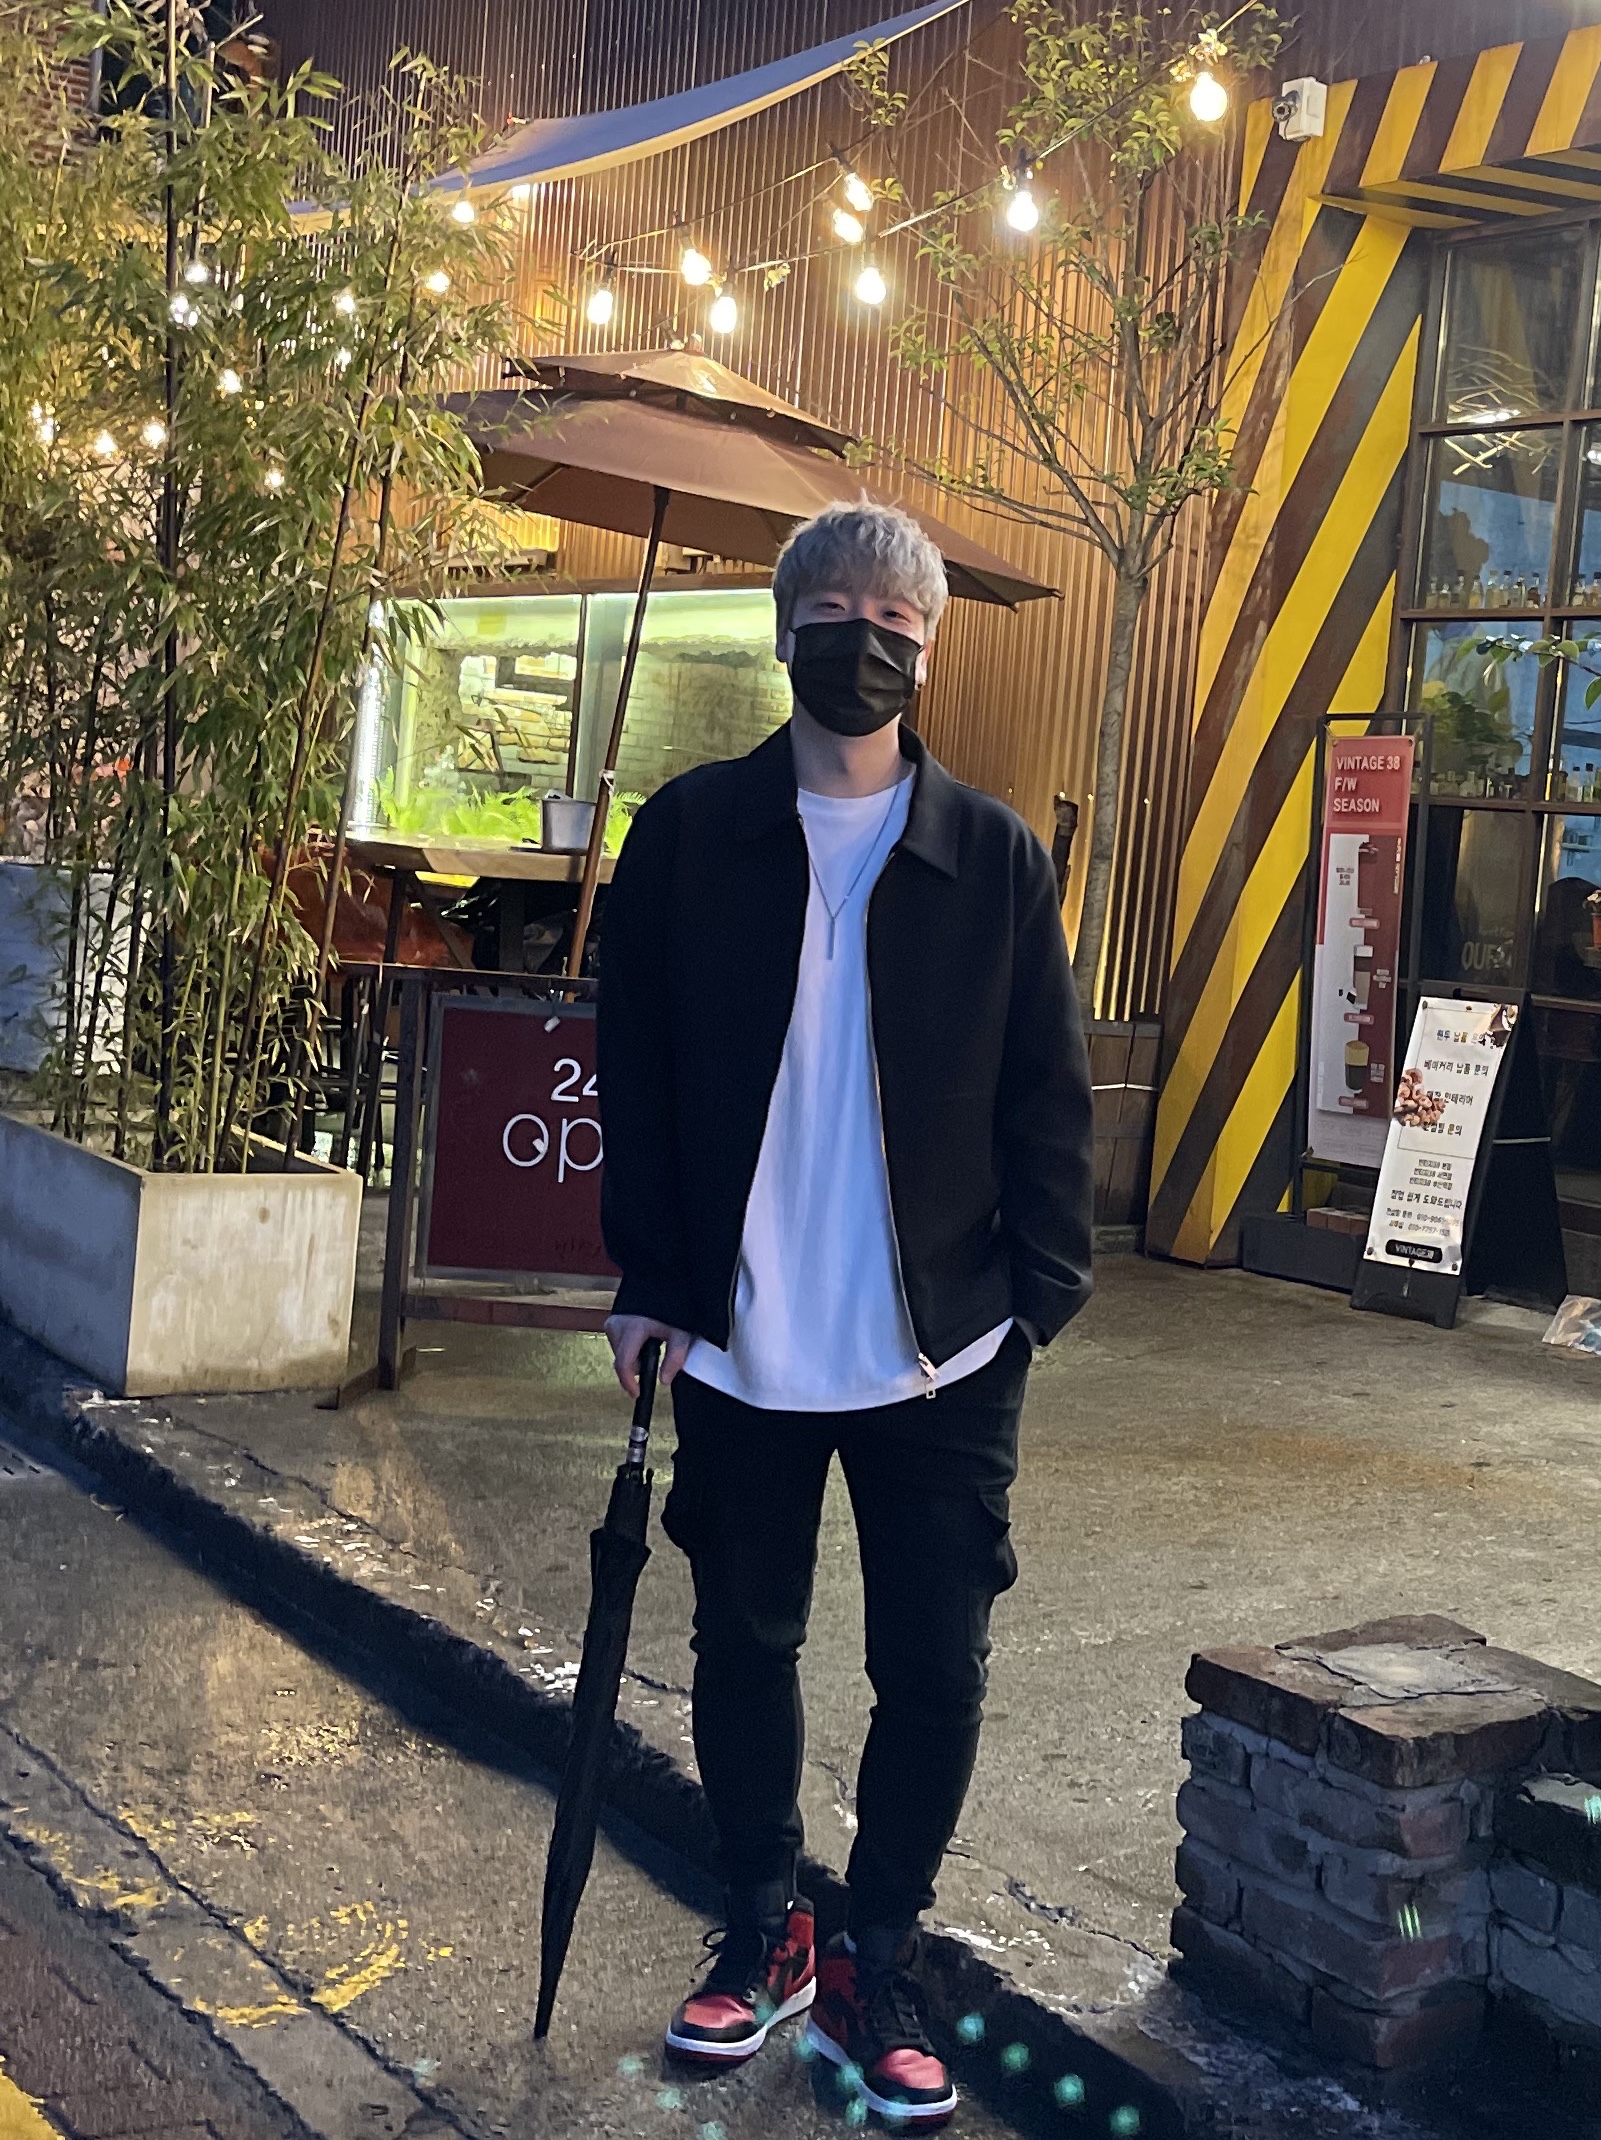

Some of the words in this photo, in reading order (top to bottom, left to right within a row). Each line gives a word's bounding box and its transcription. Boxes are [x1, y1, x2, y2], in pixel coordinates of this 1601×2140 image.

[1336, 756, 1384, 770] VINTAGE
[1387, 755, 1400, 770] 38
[1334, 777, 1357, 791] F/W
[1333, 798, 1380, 812] SEASON
[1424, 1060, 1453, 1072] 베이커리
[1457, 1063, 1471, 1075] 납품
[1474, 1064, 1489, 1076] 문의
[1445, 1092, 1473, 1106] 인테리어
[1448, 1123, 1462, 1136] 문의
